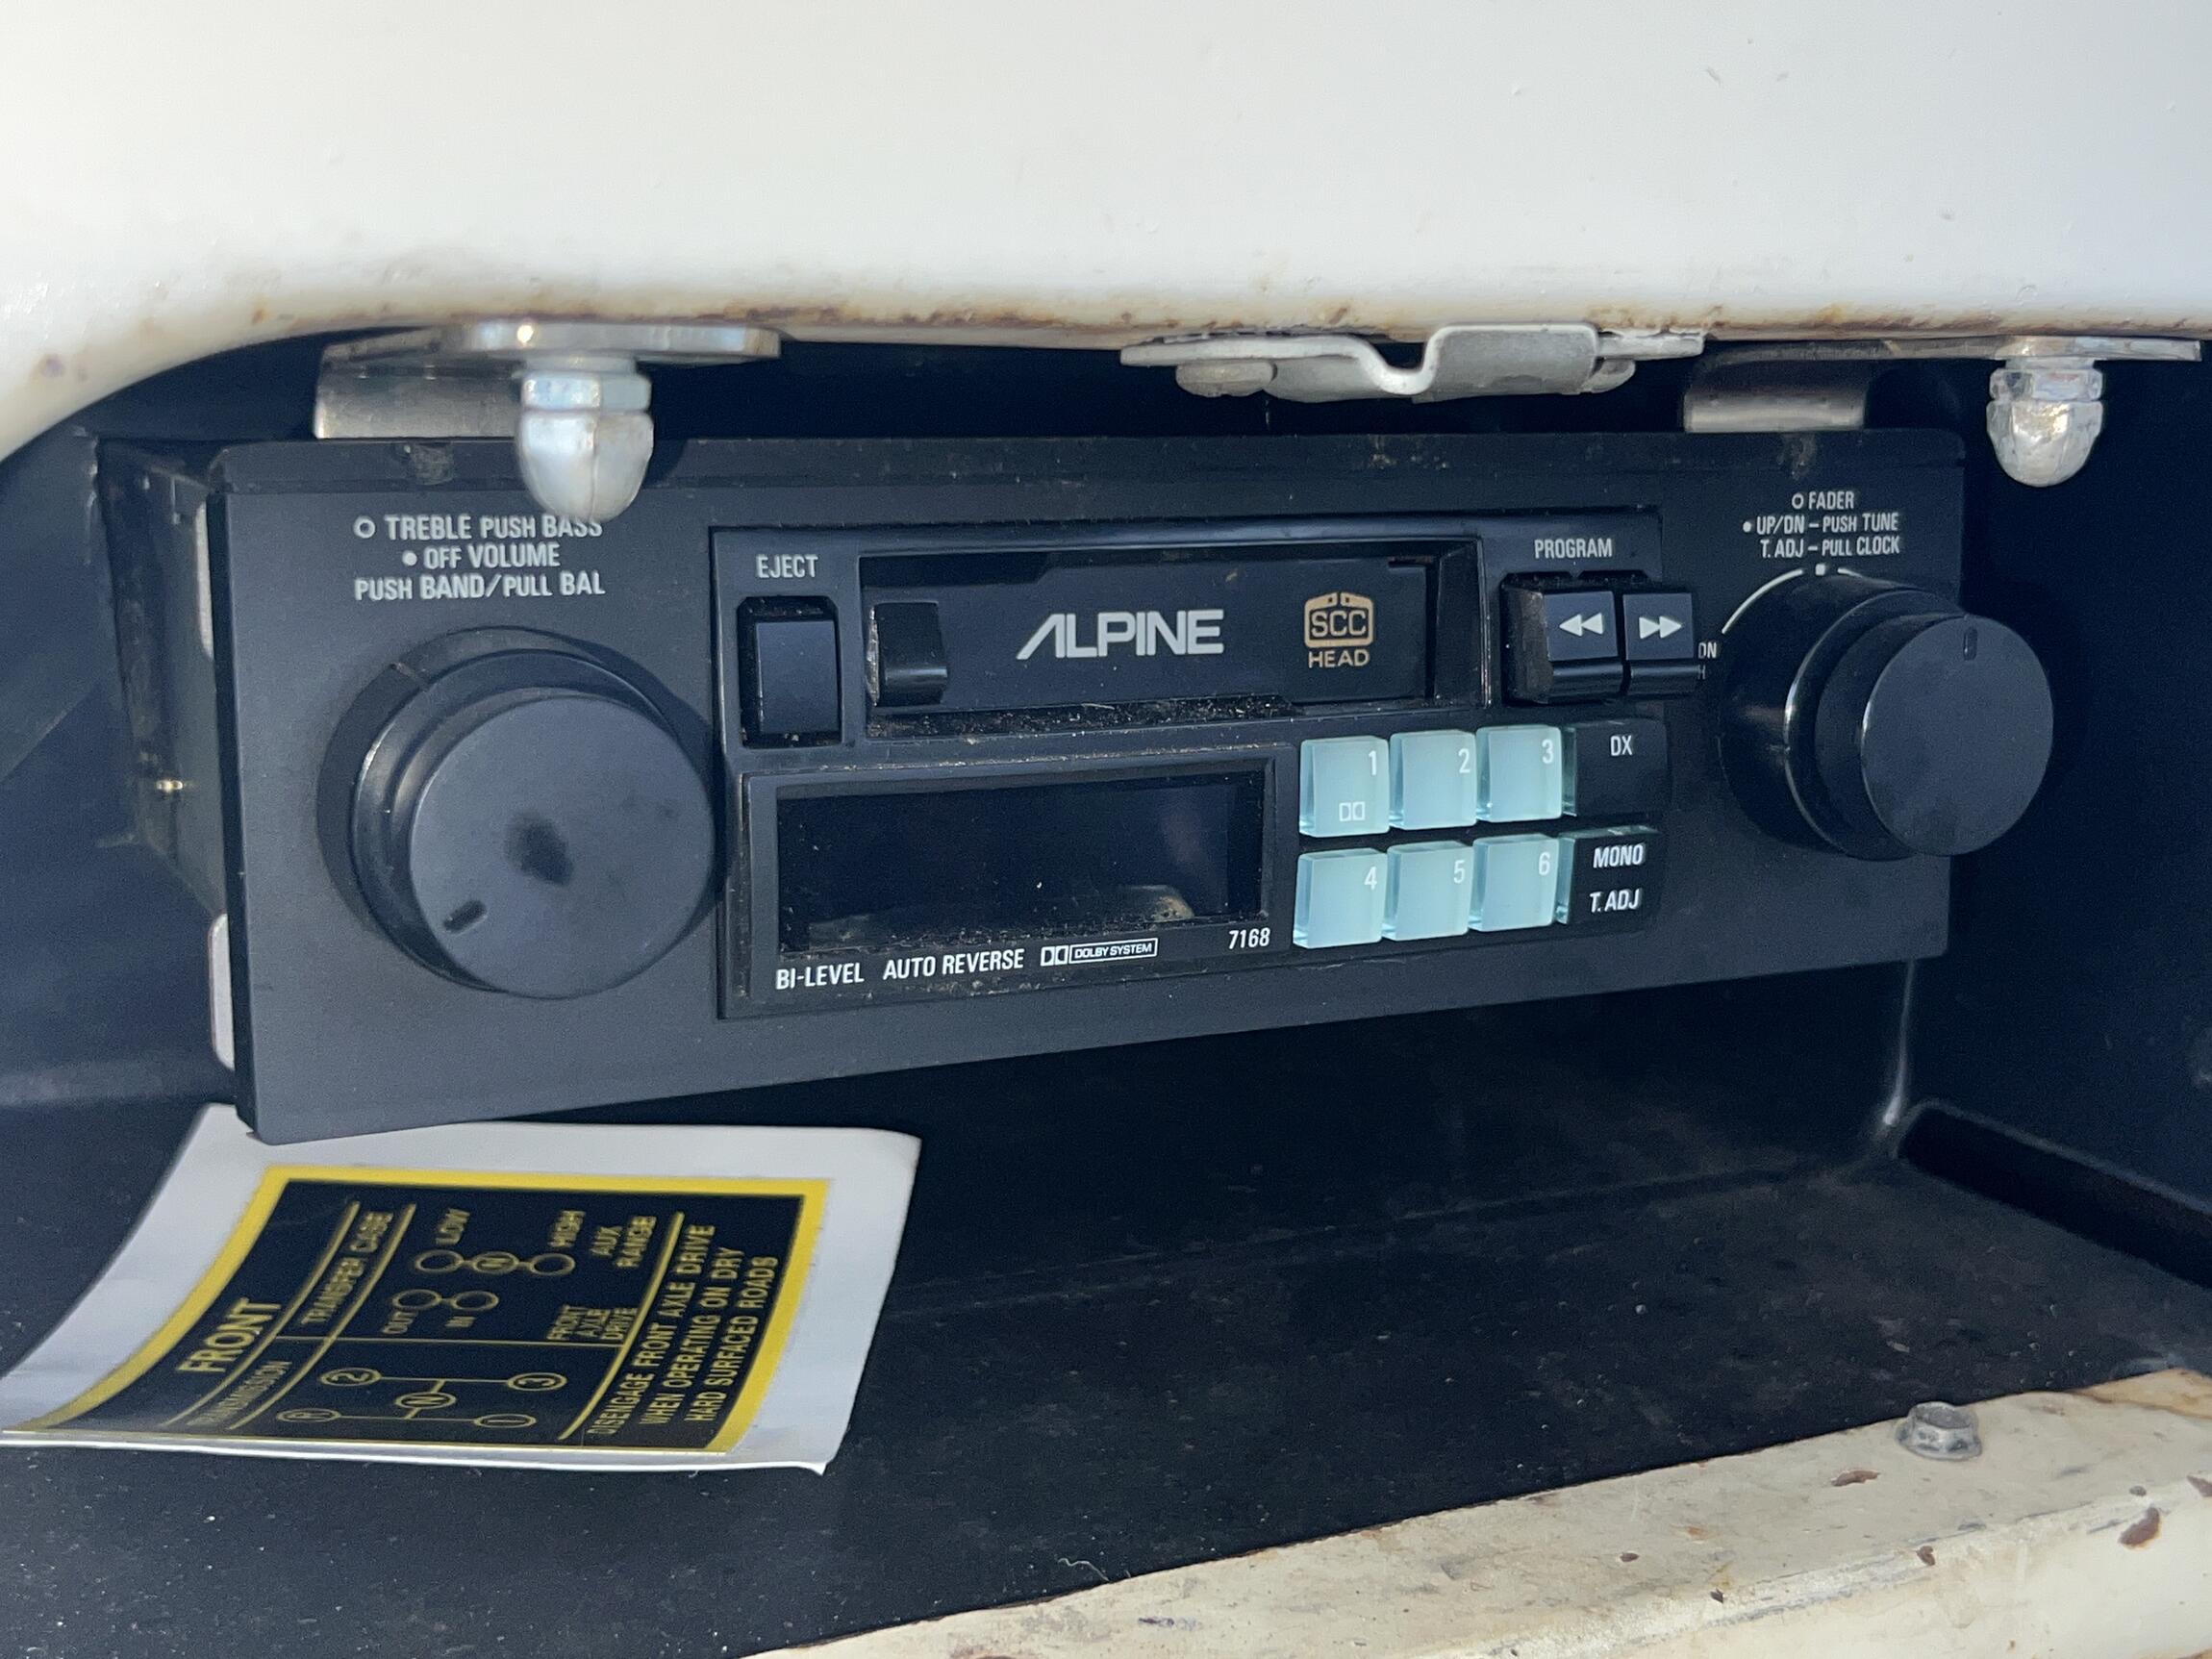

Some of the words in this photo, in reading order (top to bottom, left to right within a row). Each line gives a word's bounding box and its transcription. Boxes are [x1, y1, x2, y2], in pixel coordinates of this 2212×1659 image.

[1808, 490, 1855, 510] FADER
[385, 515, 471, 540] TREBLE
[481, 515, 536, 539] PUSH
[541, 514, 603, 538] BASS
[1756, 515, 1805, 535] UP/DN
[1822, 515, 1858, 533] PUSH
[1862, 513, 1899, 531] TUNE
[424, 546, 462, 568] OFF
[467, 542, 561, 568] VOLUME
[1534, 538, 1613, 559] PROGRAM
[1822, 540, 1853, 557] PULL
[1856, 536, 1900, 556] CLOCK
[756, 554, 818, 579] EJECT
[354, 578, 413, 600] PUSH
[560, 570, 605, 595] BAL
[1017, 609, 1224, 661] ALPINE
[1311, 610, 1367, 637] SCC
[1308, 648, 1370, 668] HEAD
[1542, 739, 1554, 765] 3
[1610, 735, 1633, 756] DX
[1368, 749, 1377, 776] 1
[1458, 747, 1471, 774] 2
[1538, 852, 1550, 876] 6
[1593, 843, 1645, 869] MONO
[1364, 866, 1378, 891] 4
[1453, 859, 1466, 884] 5
[1074, 946, 1109, 959] DOLBY
[1110, 943, 1152, 956] SYSTEM
[1228, 928, 1271, 950] 7168
[776, 962, 865, 991] BI-LEVEL
[883, 955, 936, 981] AUTO
[942, 948, 1025, 975] REVERSE
[349, 1212, 393, 1253] CASE
[435, 1208, 470, 1245] LOW
[590, 1225, 623, 1258] AUX
[615, 1216, 657, 1268] RANGE
[675, 1224, 716, 1275] DRIVE
[710, 1246, 745, 1280] DRY
[738, 1256, 779, 1309] ROADS
[656, 1281, 695, 1318] AXLE
[699, 1286, 732, 1308] ON
[178, 1296, 281, 1373] FRONT
[381, 1310, 419, 1334] OUT
[632, 1321, 677, 1367] FRONT
[662, 1314, 721, 1388] OPERATING
[703, 1315, 759, 1387] SURFACED
[586, 1372, 655, 1435] DISENGAGE
[639, 1392, 687, 1424] WHEN
[684, 1391, 728, 1422] HARD
